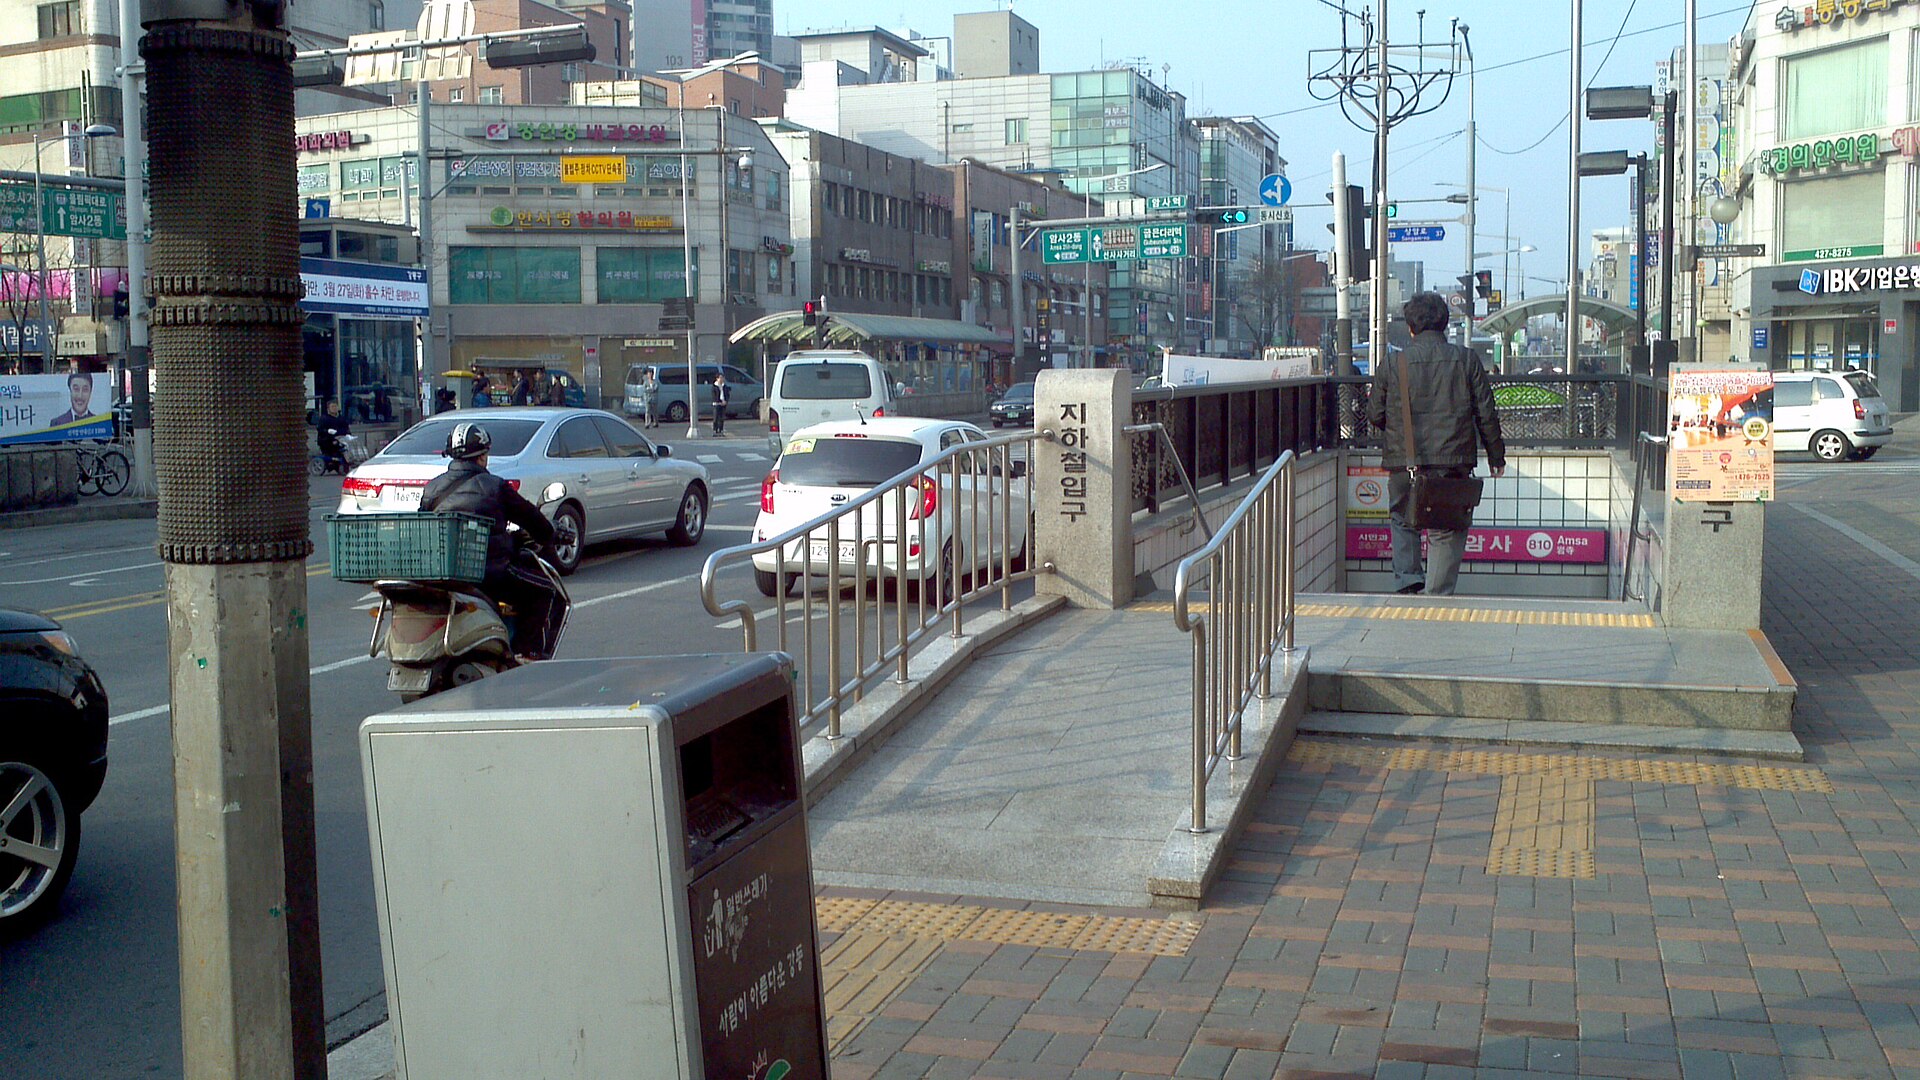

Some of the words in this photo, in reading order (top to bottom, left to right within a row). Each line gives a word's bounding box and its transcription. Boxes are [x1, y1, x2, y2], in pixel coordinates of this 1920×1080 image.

[666, 55, 683, 66] 103
[586, 123, 667, 143] 내과의원
[1773, 132, 1879, 174] 경희한의원
[1151, 197, 1182, 208] 암사역
[70, 215, 102, 227] 암사2동
[1260, 210, 1291, 222] 동시신호
[1049, 233, 1082, 244] 암사2동
[1815, 249, 1851, 259] 427-8275
[323, 283, 336, 298] 3월
[0, 404, 35, 426] 니다
[1060, 402, 1088, 523] 지하철입구
[1465, 534, 1512, 553] 암사
[1528, 538, 1551, 550] 810
[1557, 535, 1588, 546] Amsa
[726, 872, 768, 917] 일반쓰레기
[719, 991, 748, 1037] 사람이
[750, 960, 786, 1010] 아름다운
[787, 944, 804, 978] 강동
